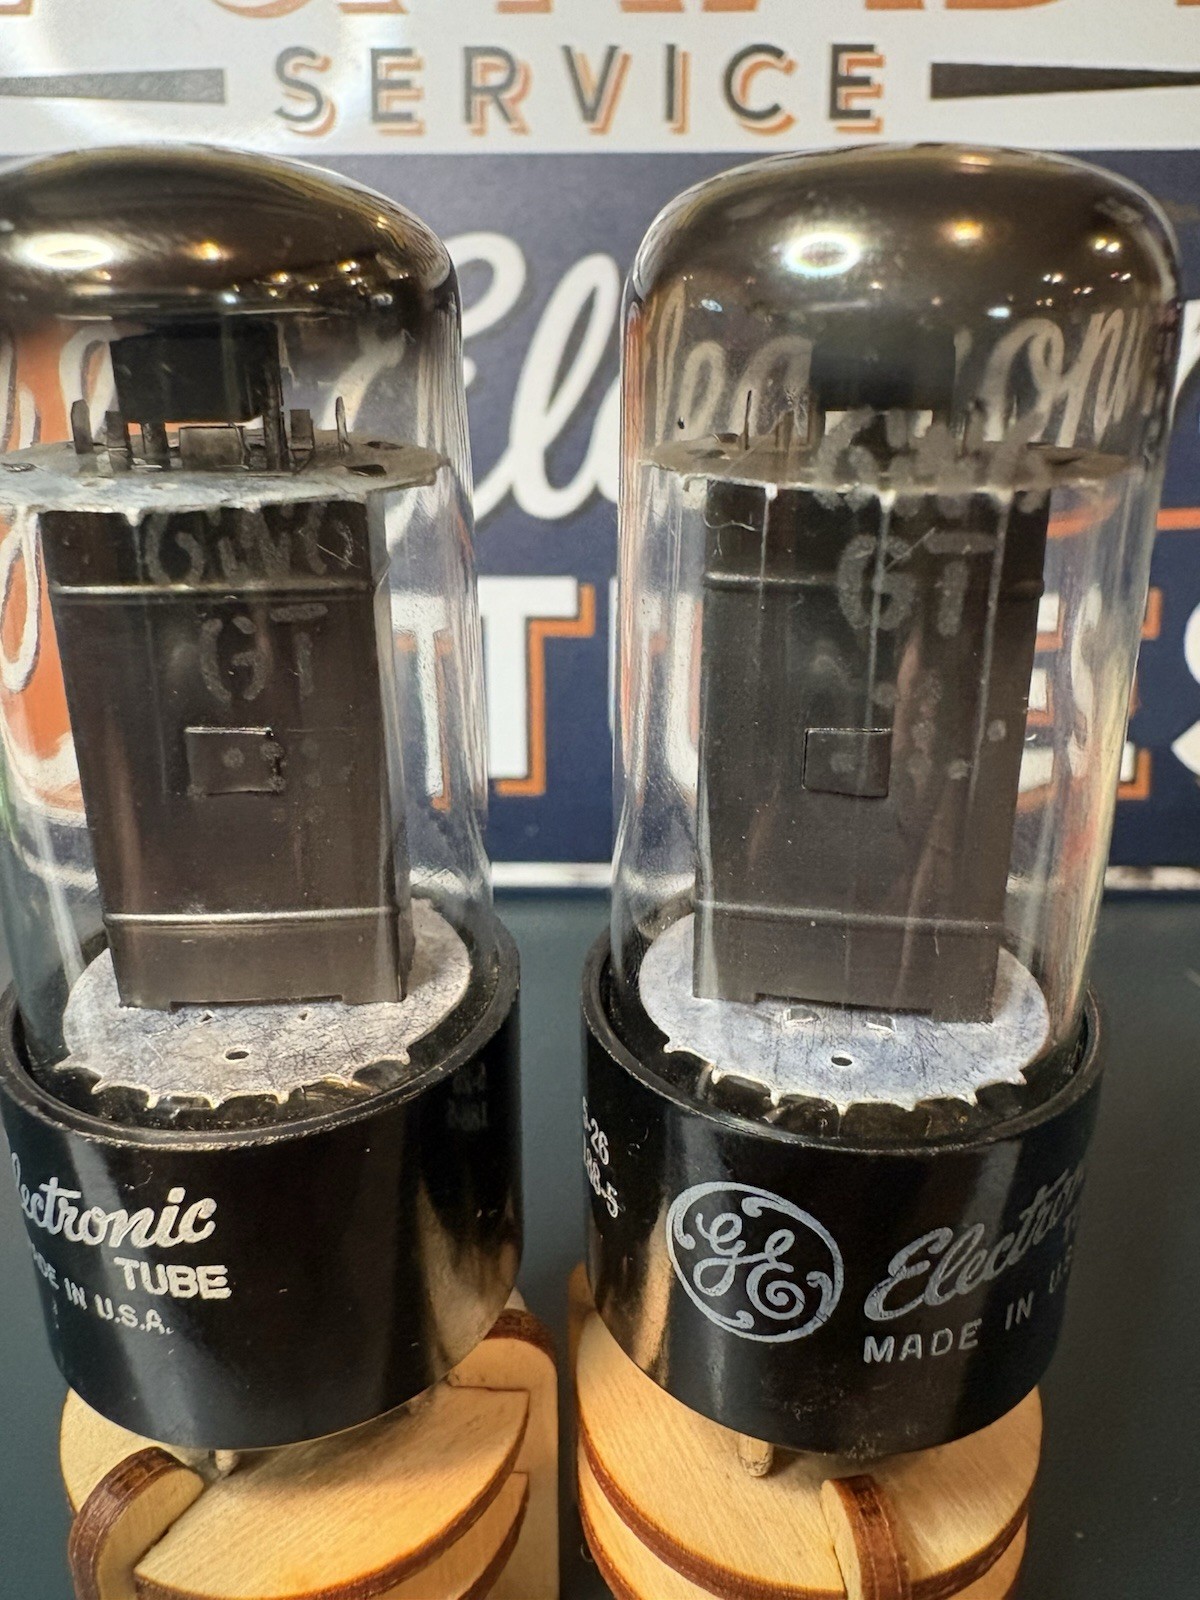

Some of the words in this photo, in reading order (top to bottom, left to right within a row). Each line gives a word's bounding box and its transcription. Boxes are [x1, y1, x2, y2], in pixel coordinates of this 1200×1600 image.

[272, 42, 882, 134] SERVICE
[11, 1152, 217, 1249] lectronic
[64, 1277, 87, 1311] IN
[94, 1294, 171, 1335] U.S.A.
[114, 1256, 232, 1300] TUBE
[863, 1318, 983, 1364] MADE
[1005, 1291, 1035, 1331] IN
